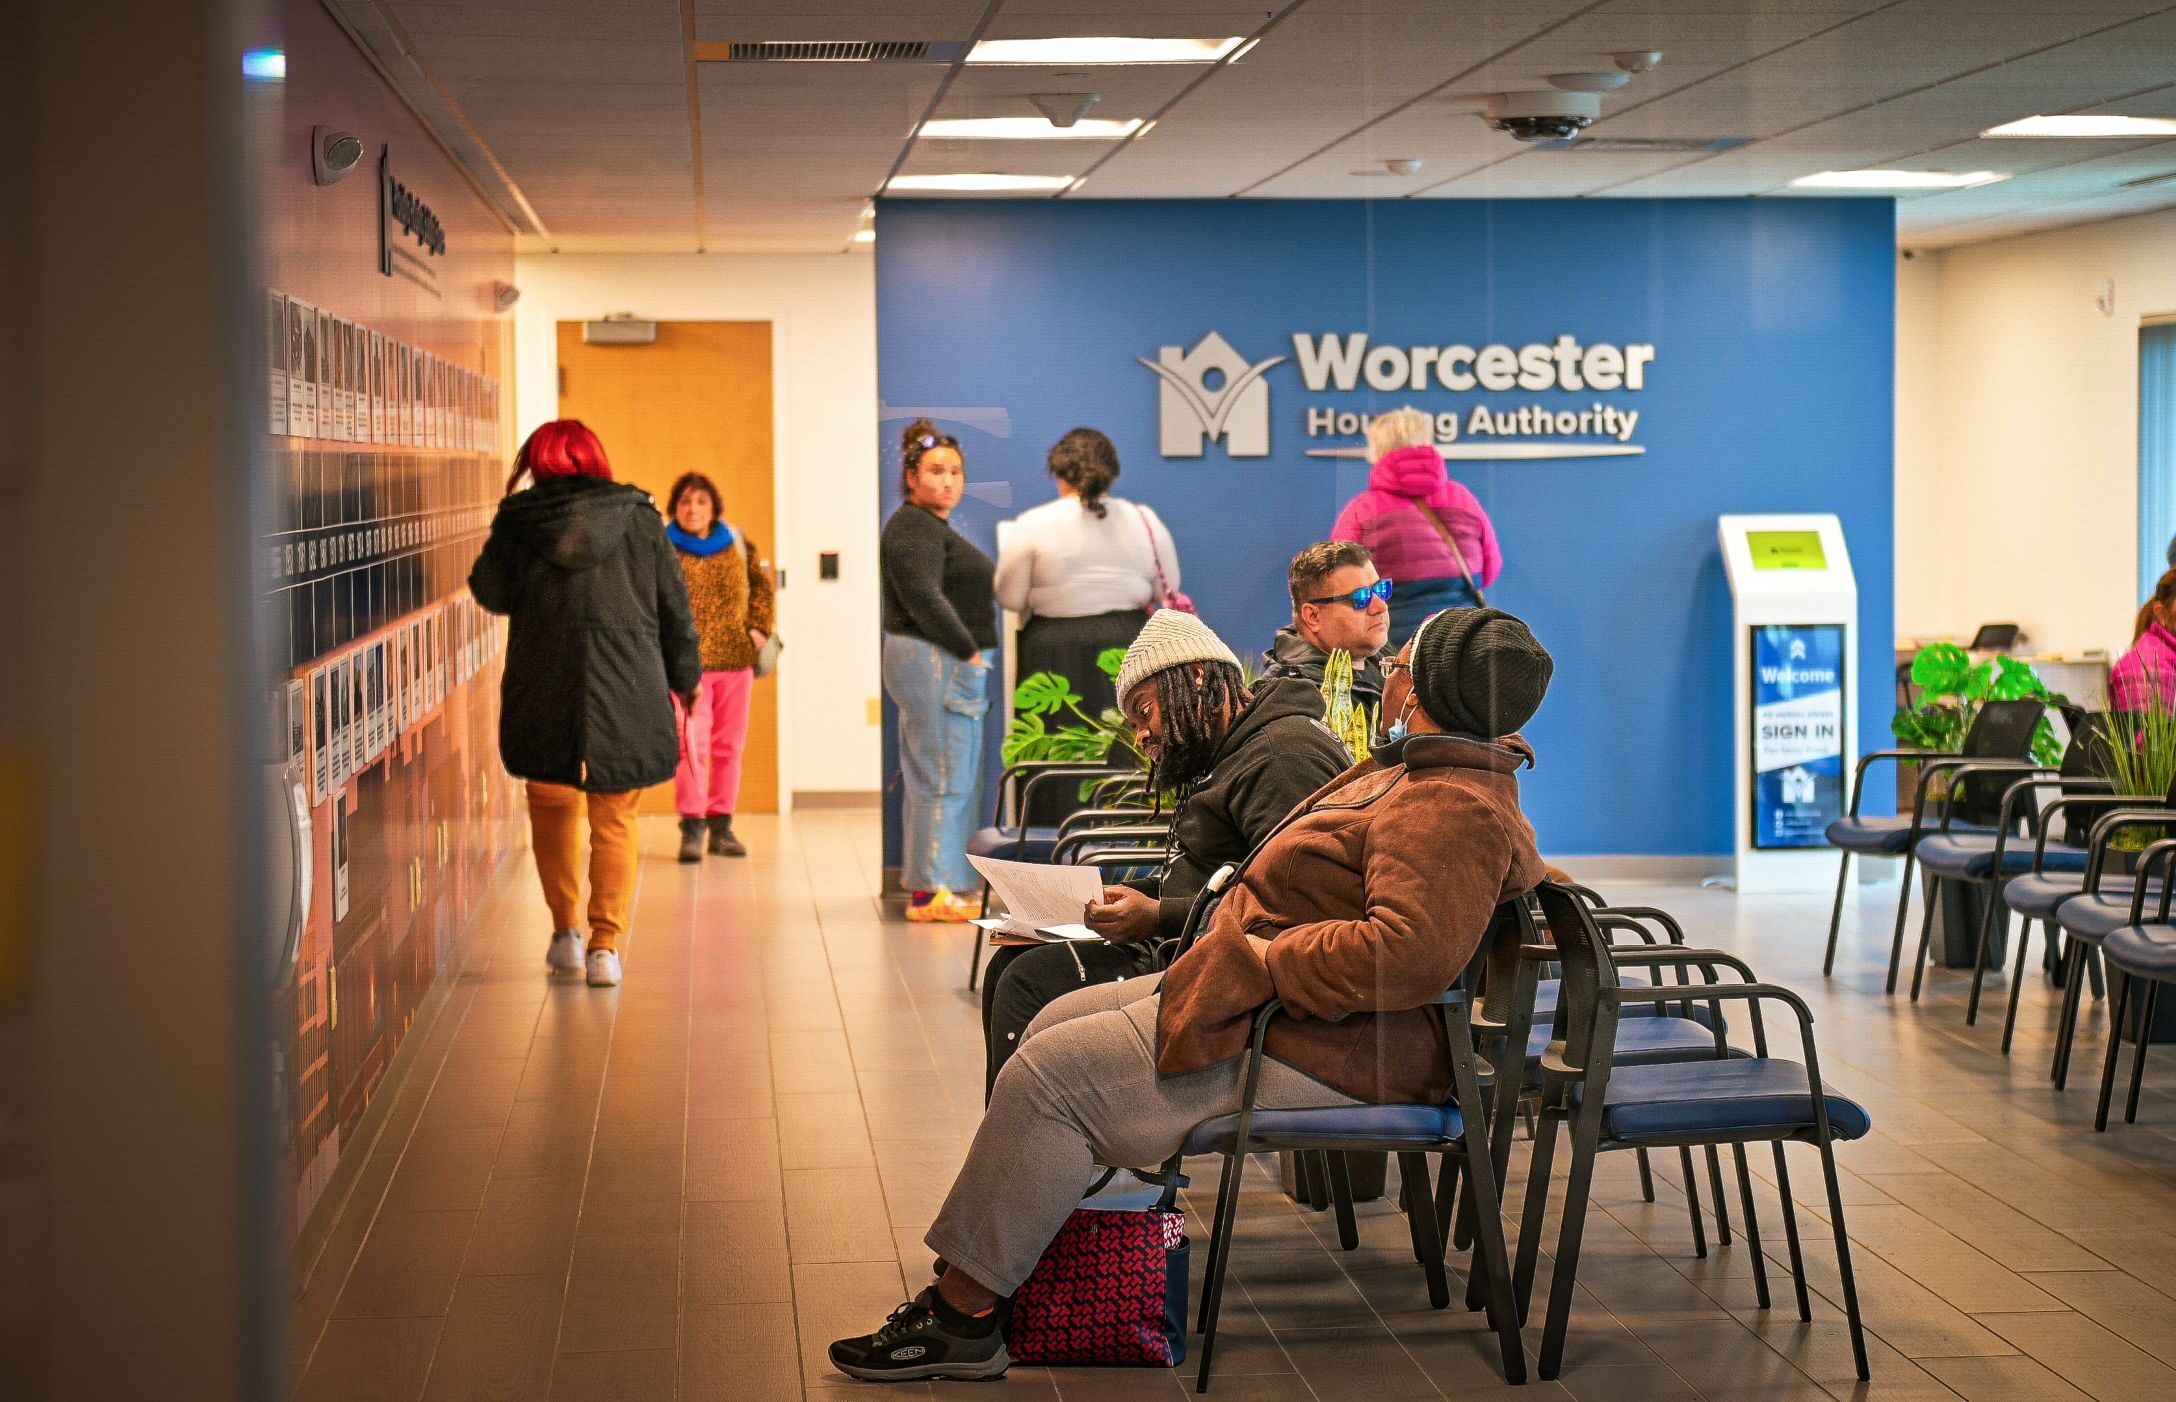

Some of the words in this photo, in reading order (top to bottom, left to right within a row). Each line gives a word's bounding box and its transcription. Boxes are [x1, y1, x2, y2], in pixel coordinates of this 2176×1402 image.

[1293, 332, 1655, 391] Worcester
[1468, 403, 1639, 440] Authority
[1761, 666, 1835, 685] Welcome
[1762, 724, 1808, 740] SIGN
[1815, 724, 1835, 739] IN
[892, 1348, 925, 1358] KEEN
